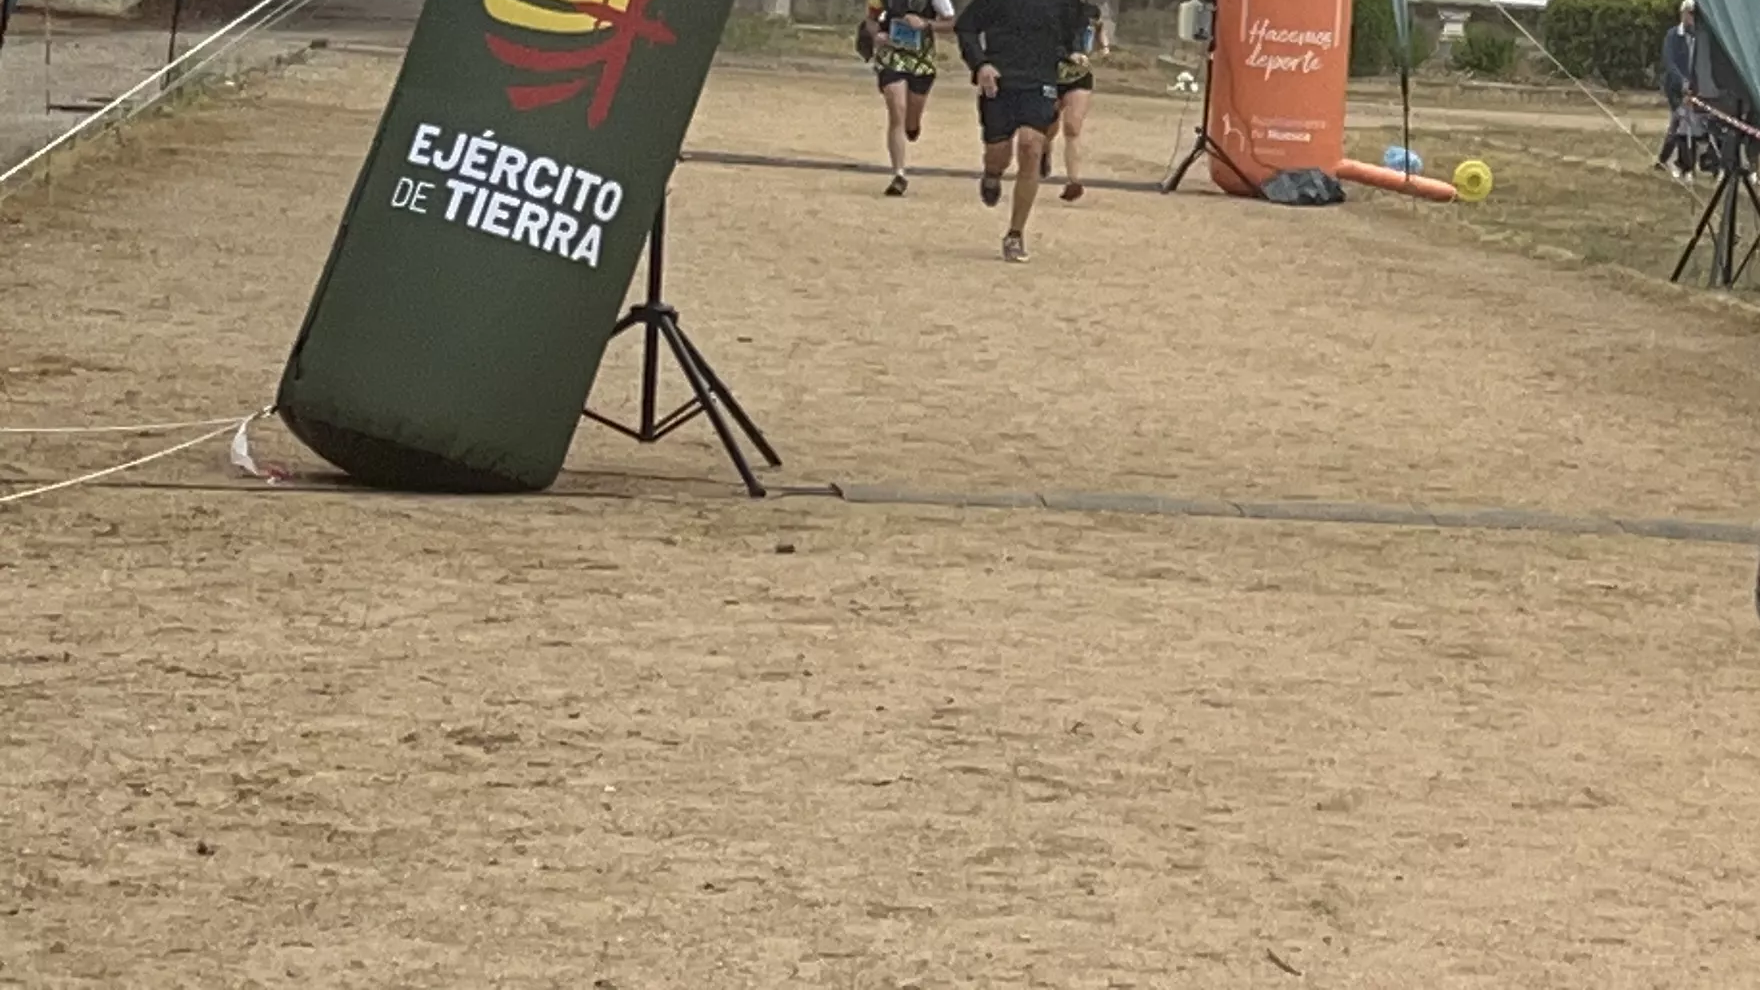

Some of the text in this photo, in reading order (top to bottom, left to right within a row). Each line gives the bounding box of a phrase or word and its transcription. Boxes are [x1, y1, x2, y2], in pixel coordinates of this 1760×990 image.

[407, 122, 624, 223] EJÉRCITO
[390, 176, 603, 269] DE TIERRA
